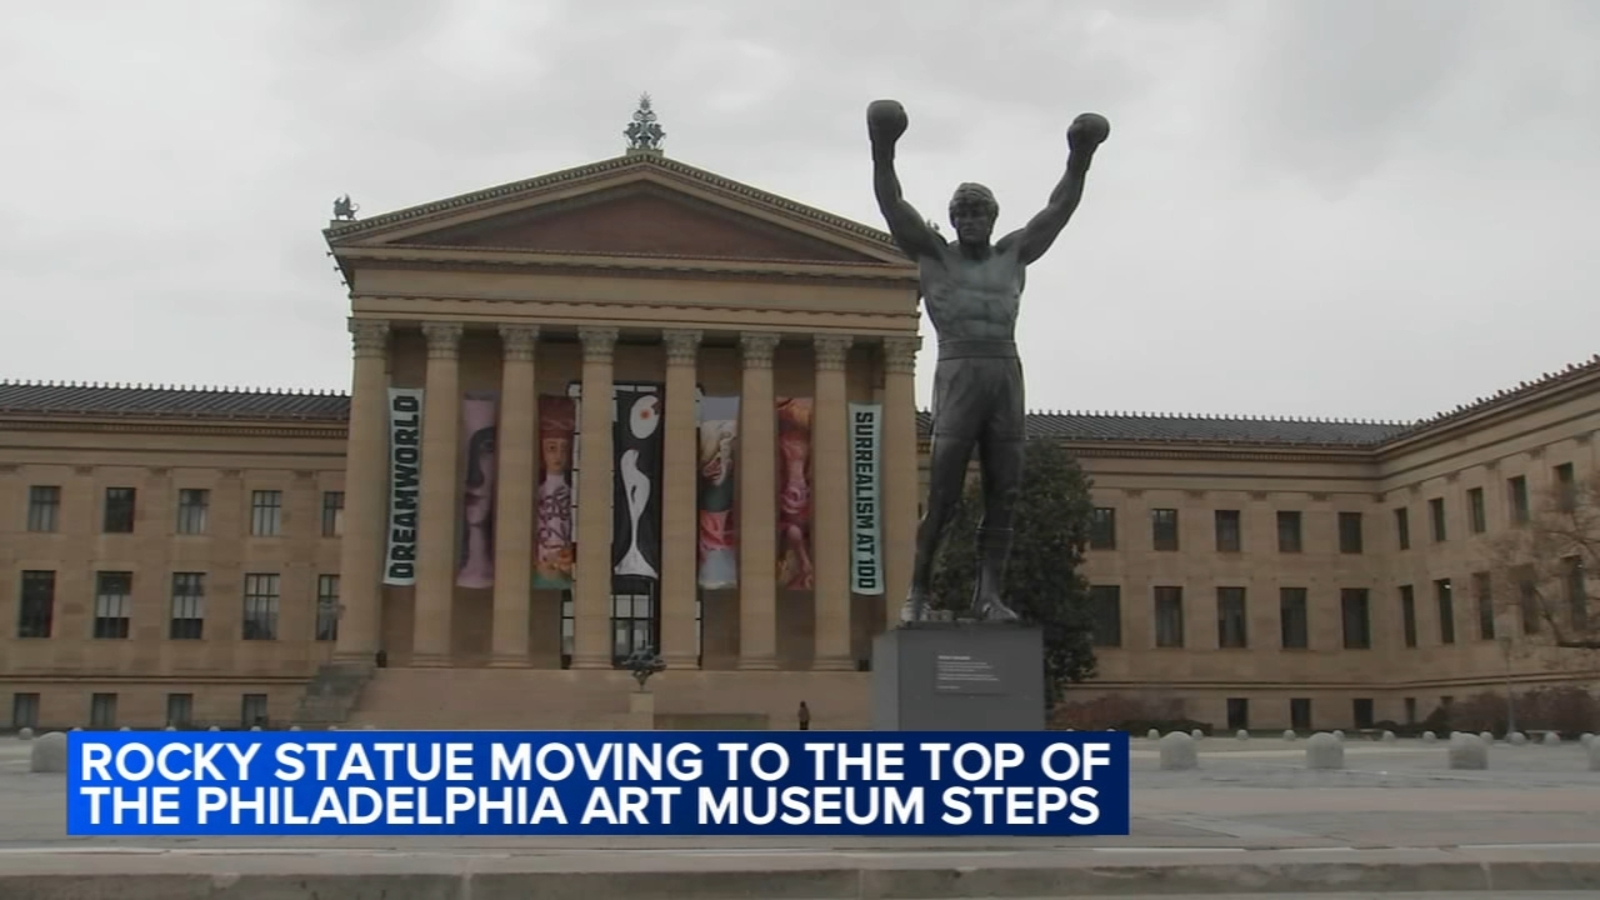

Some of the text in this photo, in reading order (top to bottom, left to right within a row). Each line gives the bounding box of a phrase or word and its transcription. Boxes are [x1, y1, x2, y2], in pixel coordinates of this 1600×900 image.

[388, 395, 420, 579] DREAMWORLD
[854, 411, 877, 590] SURREALISM AT 100
